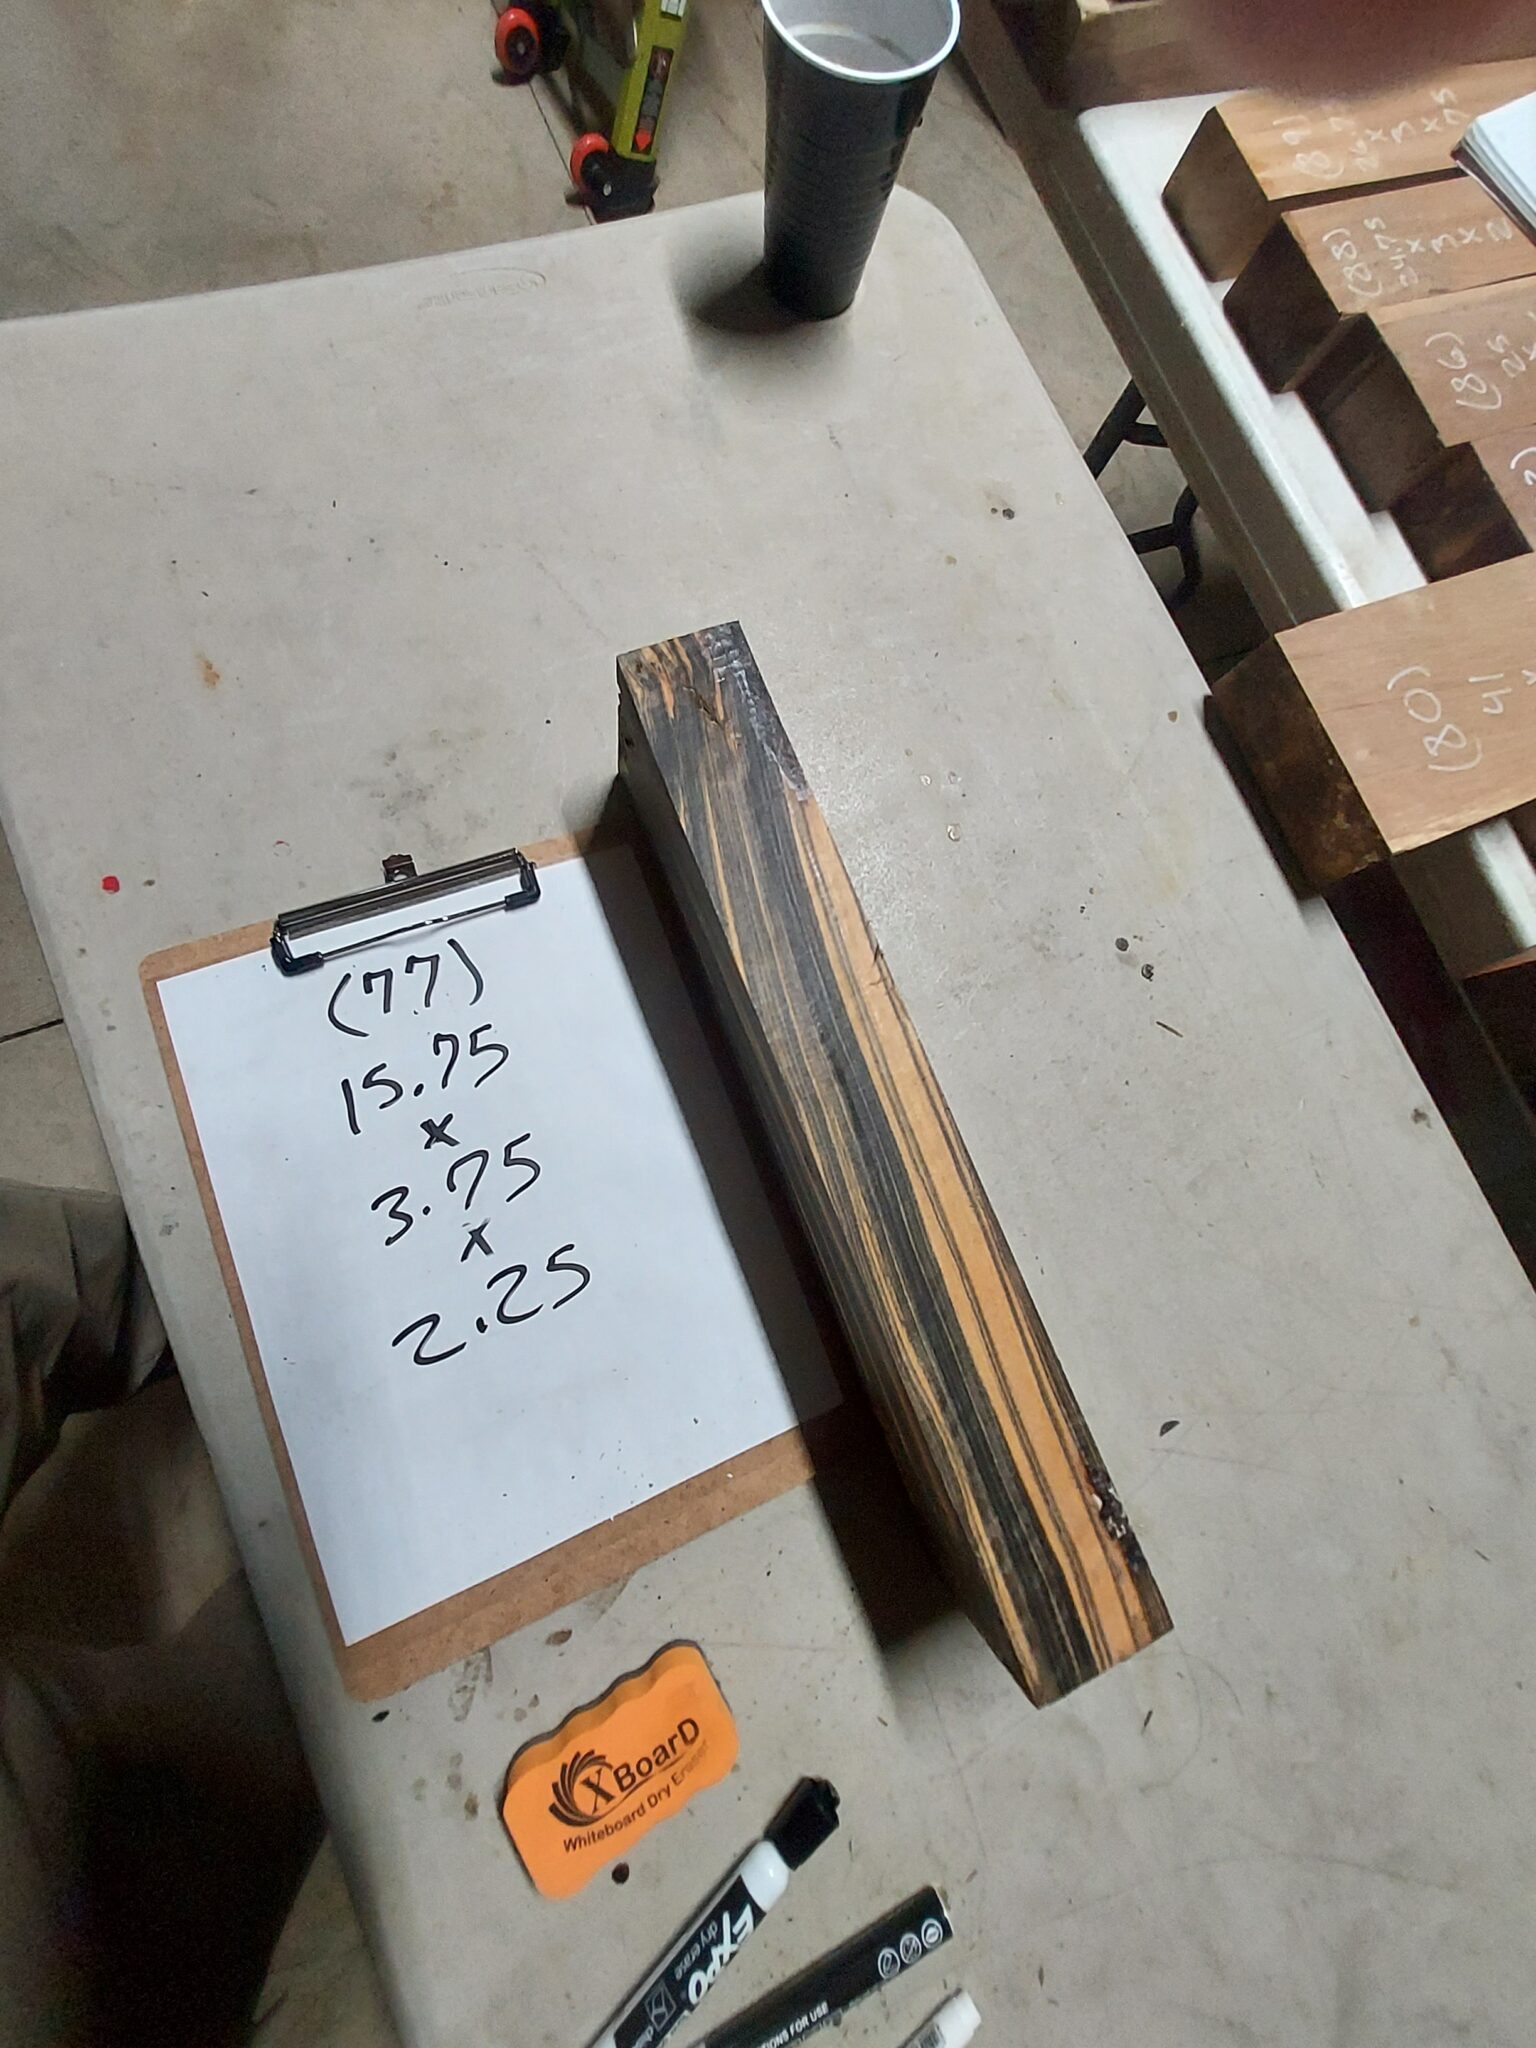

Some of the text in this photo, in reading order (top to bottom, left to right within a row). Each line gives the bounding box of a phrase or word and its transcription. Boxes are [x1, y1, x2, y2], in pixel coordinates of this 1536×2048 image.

[1322, 228, 1383, 297] (88)
[1424, 332, 1502, 410] (86)
[1386, 665, 1484, 772] (80)
[1467, 672, 1513, 715] 41
[327, 938, 485, 1038] (77)
[341, 1023, 510, 1136] 15.75
[370, 1133, 541, 1247] 3.75
[391, 1243, 592, 1367] 2.25
[562, 1801, 648, 1855] Whiteboard
[646, 1781, 673, 1812] Dry
[688, 1903, 757, 2005] EXPO
[789, 2014, 810, 2037] FOR
[809, 2000, 829, 2022] USE
